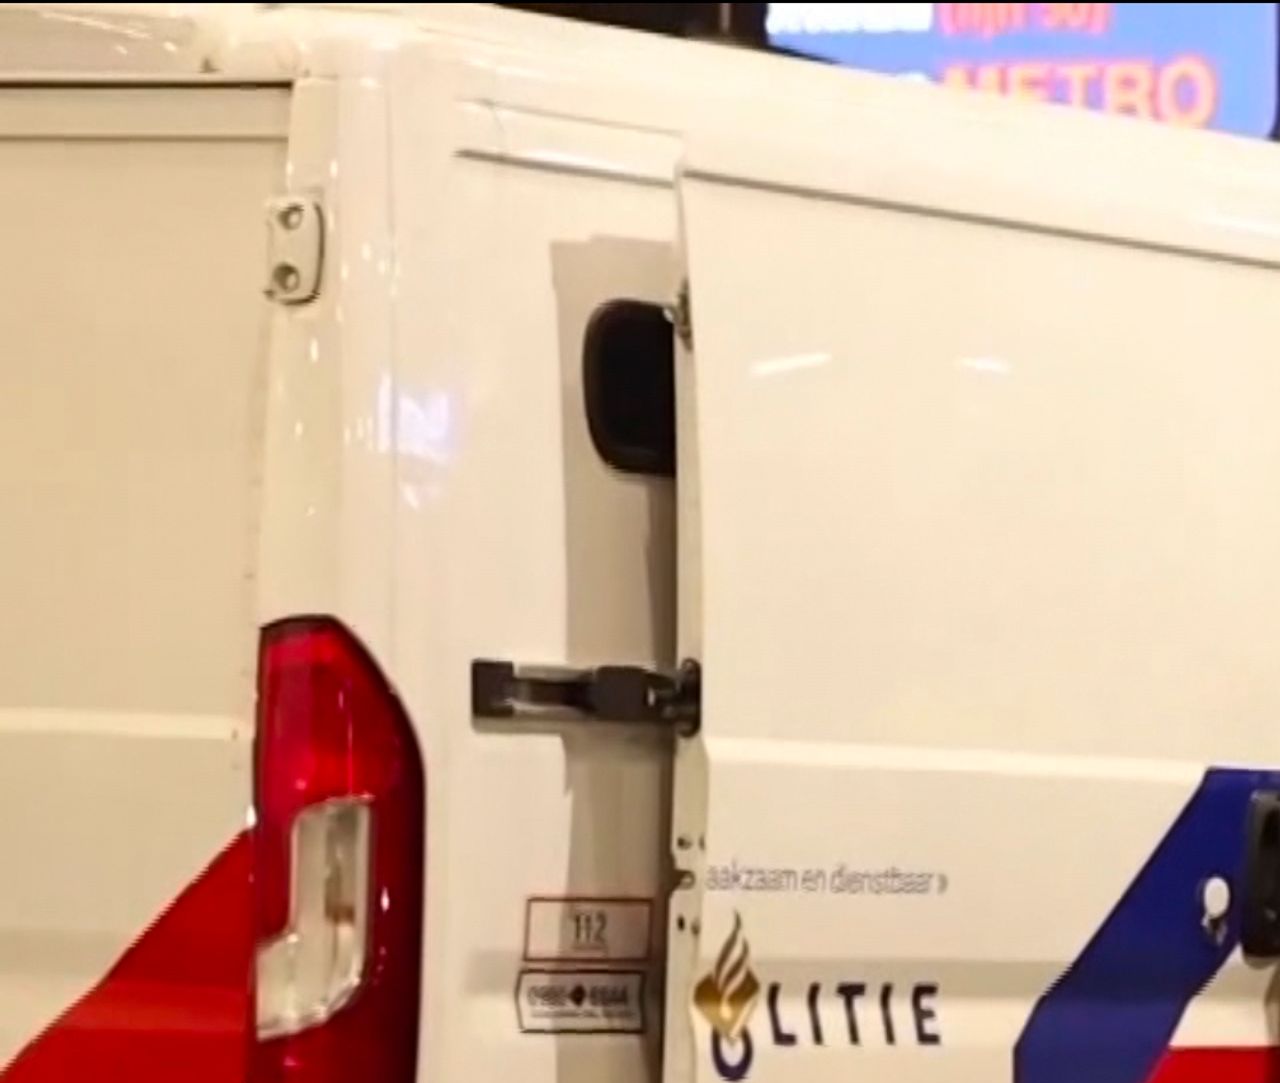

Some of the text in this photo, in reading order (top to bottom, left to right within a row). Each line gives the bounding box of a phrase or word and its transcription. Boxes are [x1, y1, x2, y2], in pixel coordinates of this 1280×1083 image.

[704, 861, 798, 892] aakzaam
[800, 868, 827, 892] en
[573, 911, 607, 942] 112
